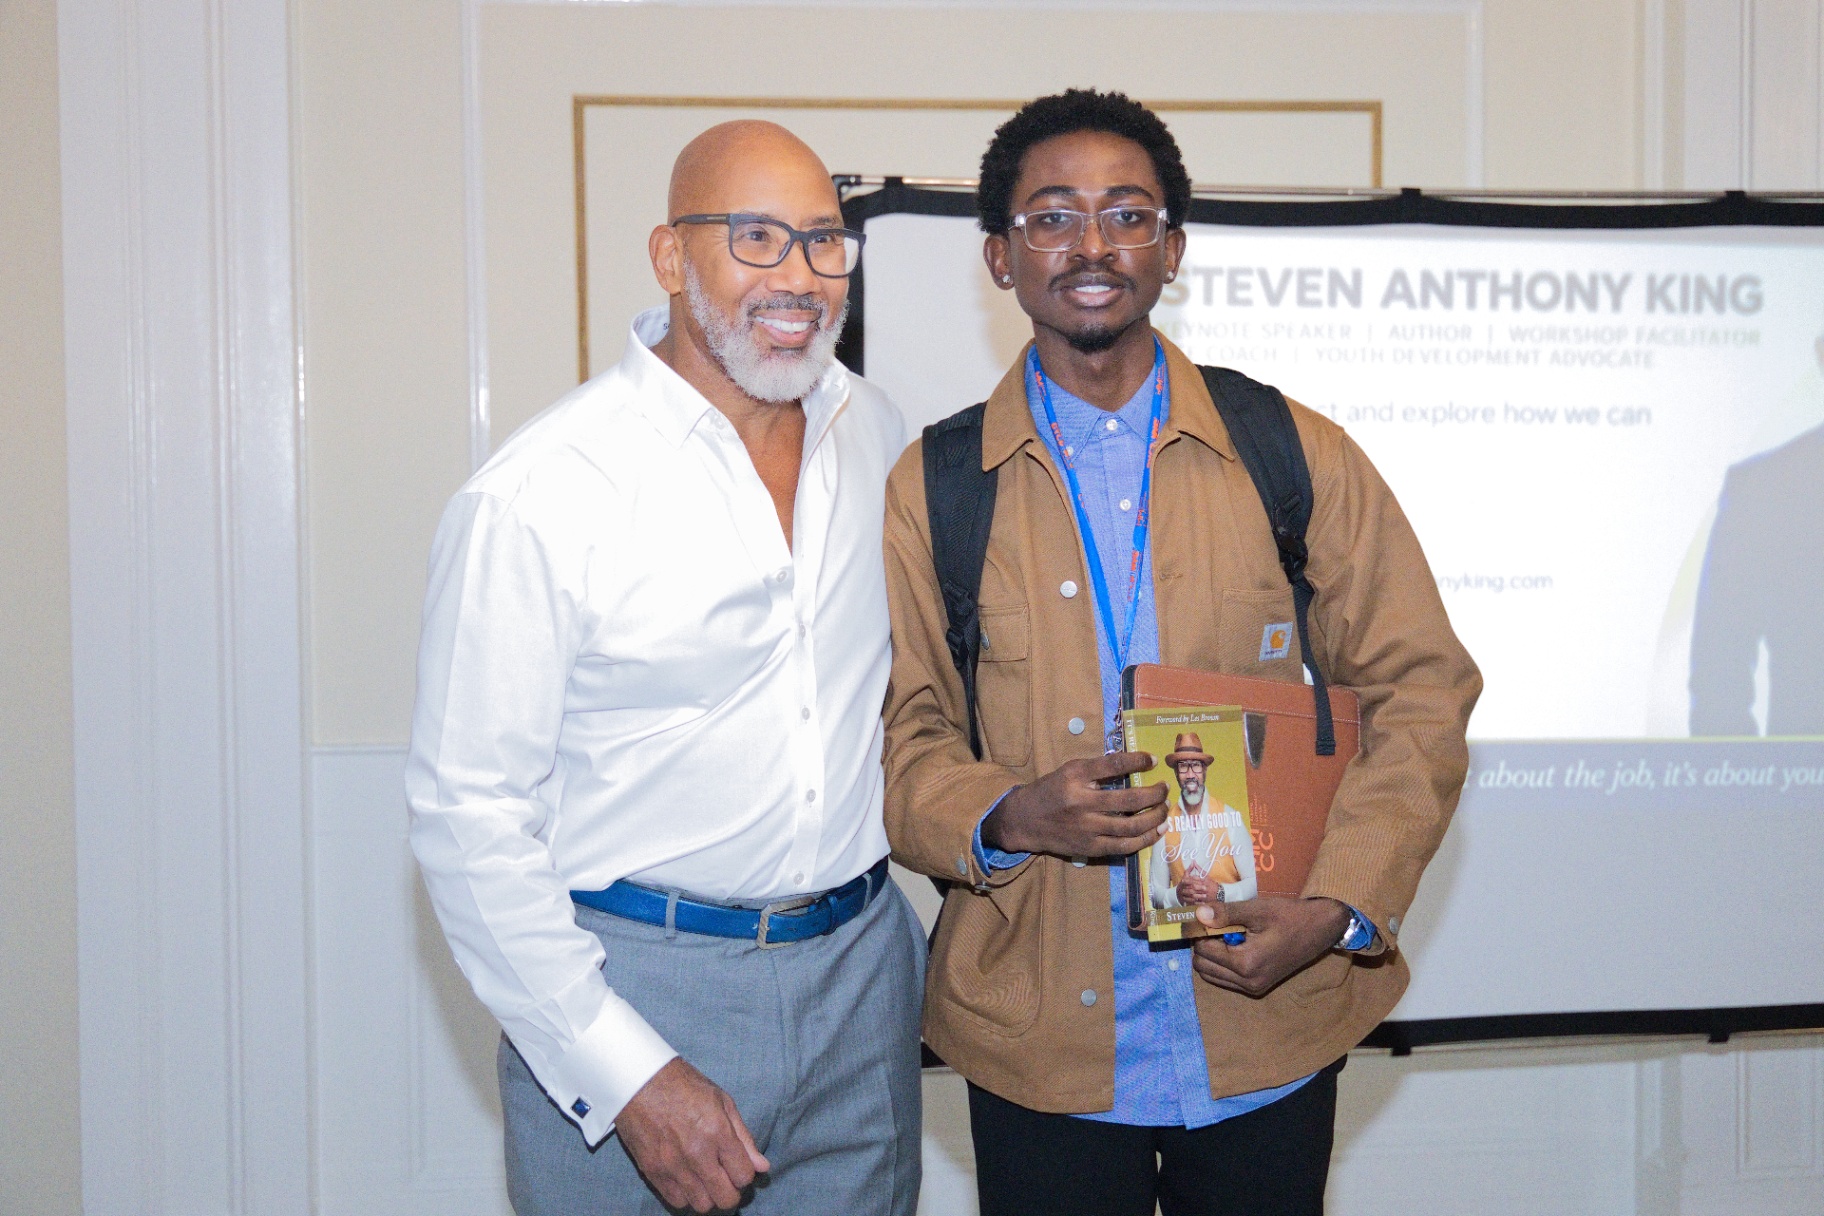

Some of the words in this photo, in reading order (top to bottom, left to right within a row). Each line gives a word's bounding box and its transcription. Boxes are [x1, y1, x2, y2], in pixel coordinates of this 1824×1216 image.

[1159, 267, 1362, 308] STEVEN
[1379, 268, 1632, 313] ANTHONY
[1647, 272, 1764, 315] KING
[1262, 321, 1352, 340] SPEAKER
[1389, 324, 1473, 342] AUTHOR
[1509, 325, 1628, 345] WORKSHOP
[1636, 326, 1761, 347] FACILITATOR
[1206, 346, 1277, 362] COACH
[1316, 347, 1384, 363] YOUTH
[1393, 347, 1539, 366] DEVELOPMENT
[1550, 349, 1653, 368] ADVOCATE
[1347, 401, 1394, 423] and
[1402, 401, 1496, 428] explore
[1503, 400, 1557, 425] how
[1563, 405, 1601, 425] we
[1606, 405, 1652, 427] can
[1436, 572, 1553, 593] nyking.com
[1479, 759, 1556, 789] about
[1564, 760, 1606, 789] the
[1605, 758, 1655, 796] job,
[1663, 760, 1698, 787] it's
[1704, 760, 1777, 786] about
[1174, 813, 1204, 832] REALLY
[1206, 811, 1229, 829] GOOD
[1230, 811, 1242, 828] TO
[1160, 834, 1199, 866] See
[1202, 832, 1242, 878] You
[1166, 911, 1195, 922] STEVEN
